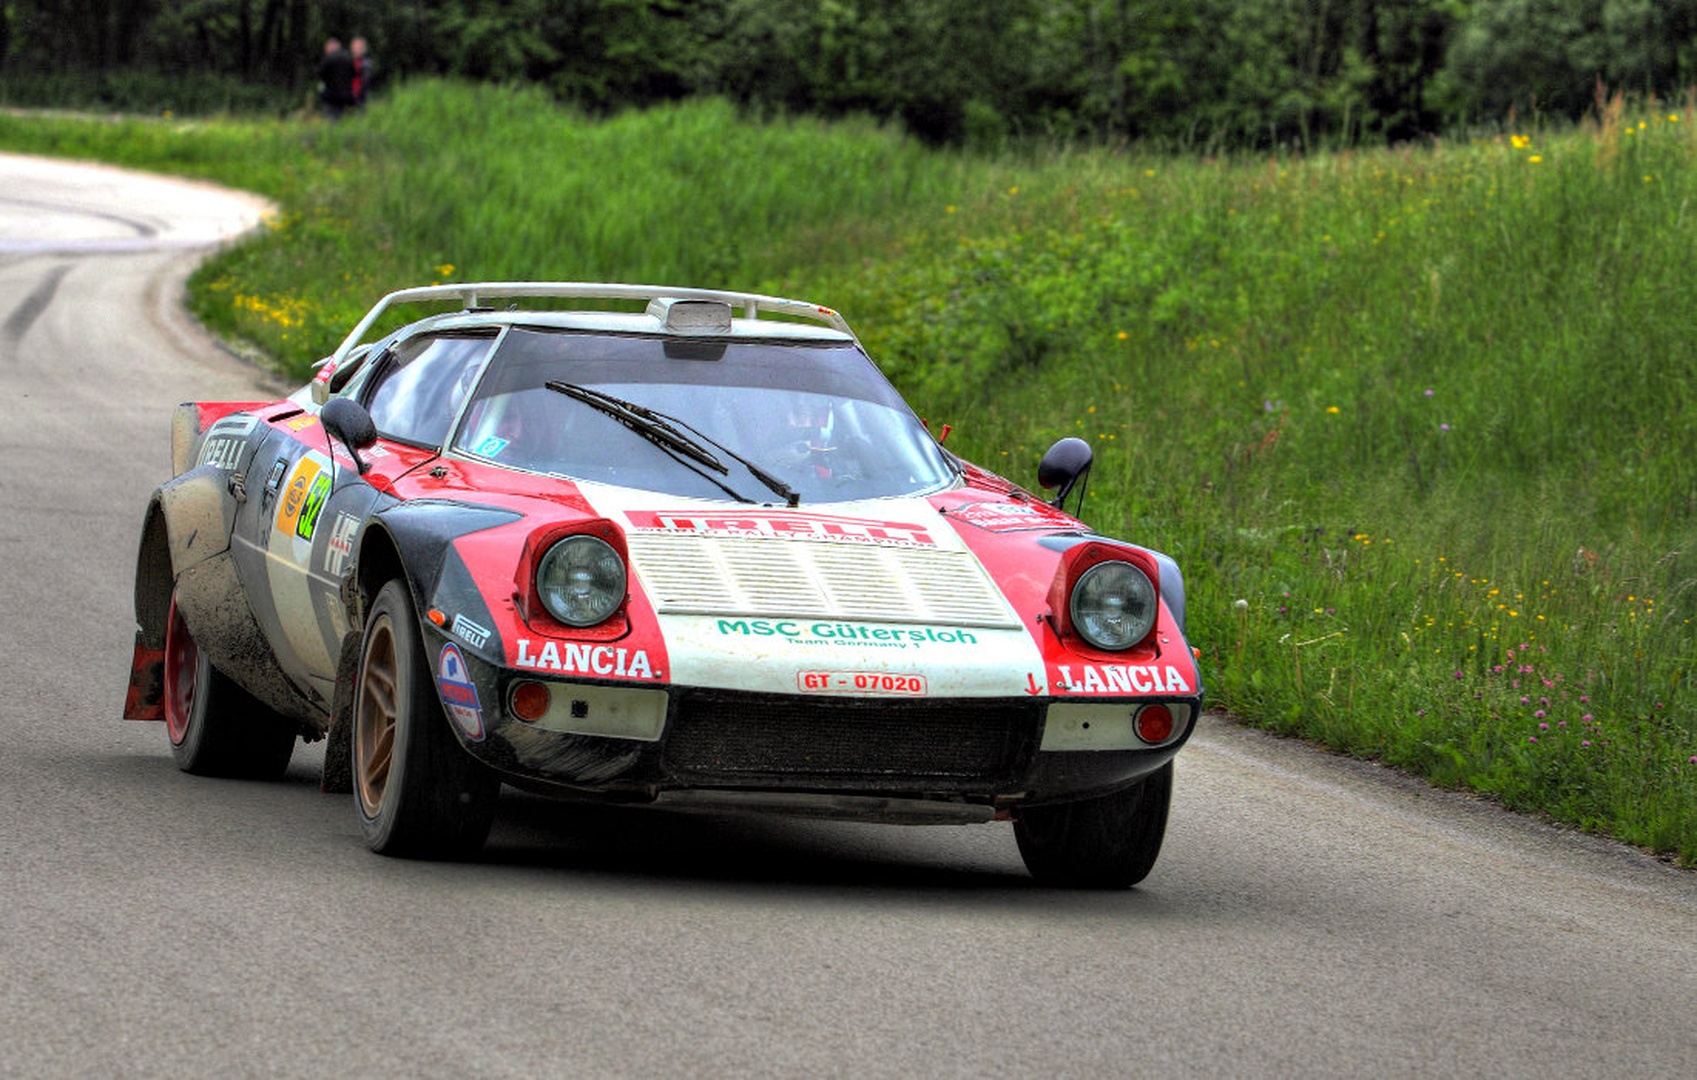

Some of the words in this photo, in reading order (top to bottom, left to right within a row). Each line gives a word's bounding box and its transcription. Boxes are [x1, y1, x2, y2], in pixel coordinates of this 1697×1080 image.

[623, 510, 936, 545] PIRELLI
[728, 530, 796, 538] RALLY
[808, 533, 939, 548] CHAMPIONS
[452, 613, 492, 650] PIRELLI
[717, 619, 800, 636] MSC
[811, 622, 978, 644] Gütersloh
[786, 637, 829, 645] Team
[833, 639, 907, 648] Germany
[515, 639, 653, 679] LANCIA
[804, 673, 831, 688] GT
[854, 675, 921, 692] 07020
[1058, 665, 1190, 693] LANCIA
